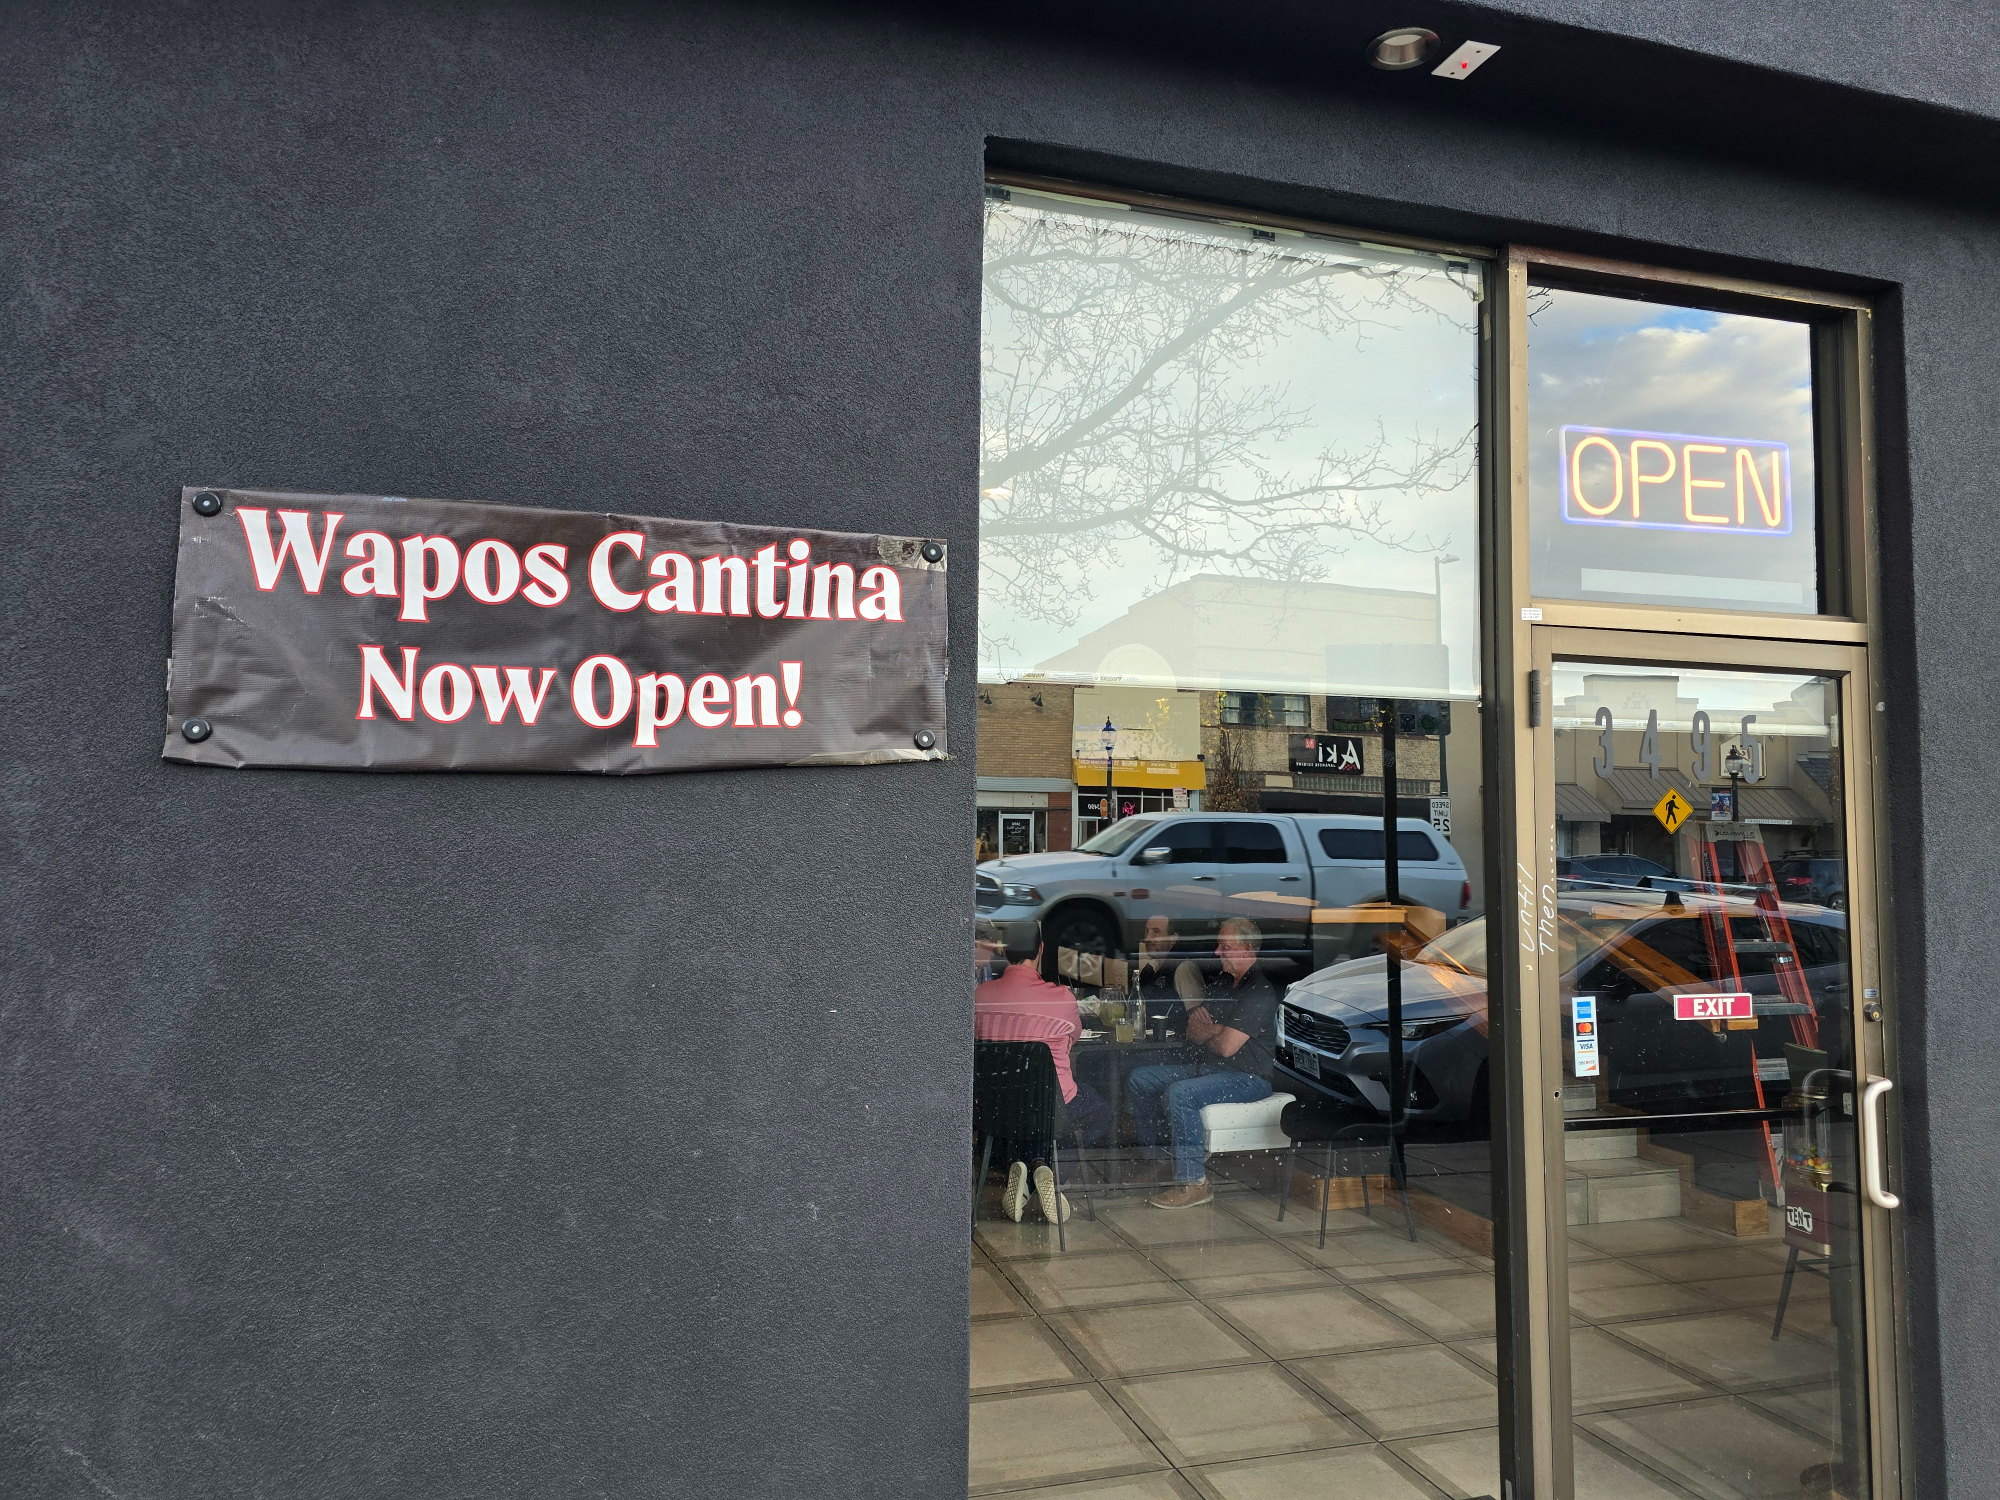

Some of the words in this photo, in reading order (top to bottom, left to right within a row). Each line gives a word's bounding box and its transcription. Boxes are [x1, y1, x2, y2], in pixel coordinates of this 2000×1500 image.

[1571, 435, 1782, 528] OPEN
[235, 506, 570, 622] Wapos
[588, 531, 905, 622] Cantina
[357, 644, 558, 725] Now
[570, 653, 804, 748] Open!
[1593, 706, 1760, 785] 3495
[1693, 997, 1735, 1016] EXIT
[1787, 1207, 1811, 1229] TENT
